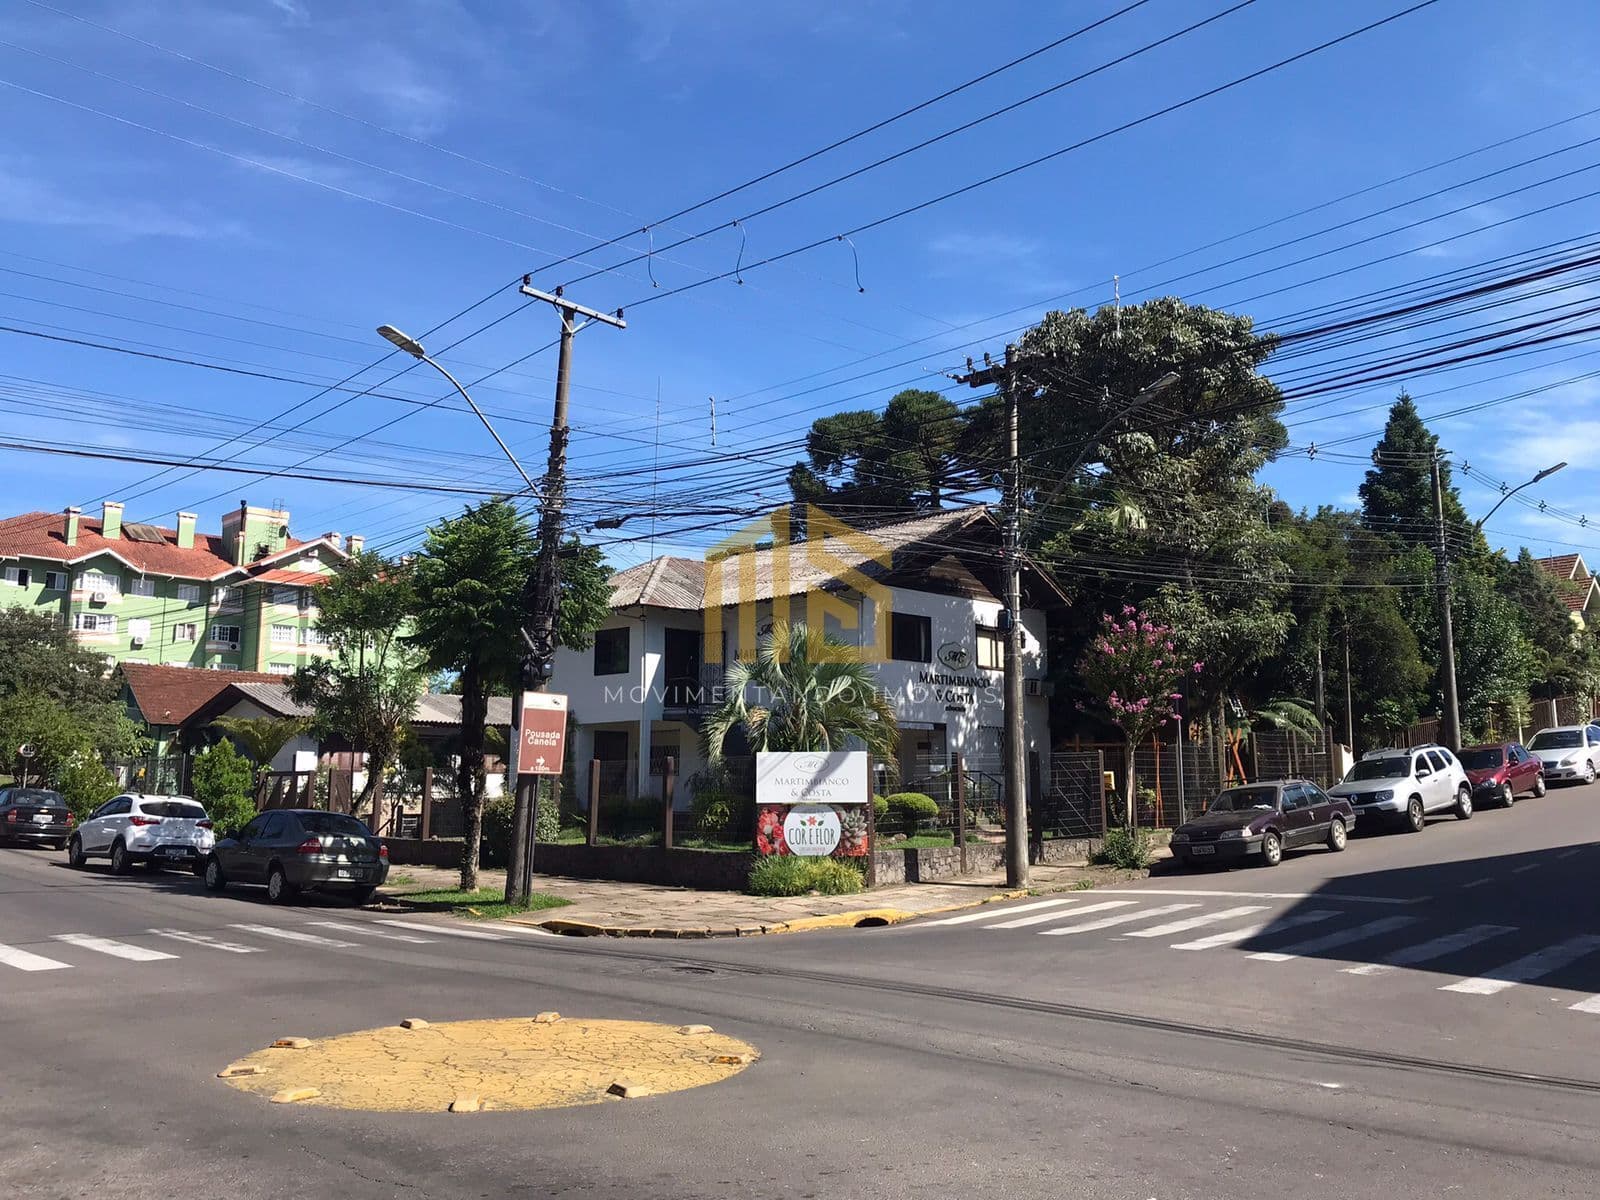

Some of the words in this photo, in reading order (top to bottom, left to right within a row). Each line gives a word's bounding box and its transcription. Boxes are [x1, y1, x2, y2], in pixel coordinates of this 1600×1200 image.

[945, 690, 974, 705] COSTA
[526, 729, 560, 739] Pousada
[528, 737, 557, 746] Canela
[790, 789, 799, 797] &
[801, 788, 832, 797] COSTA
[788, 828, 807, 846] COR
[809, 828, 814, 845] E
[815, 828, 836, 846] FLOR
